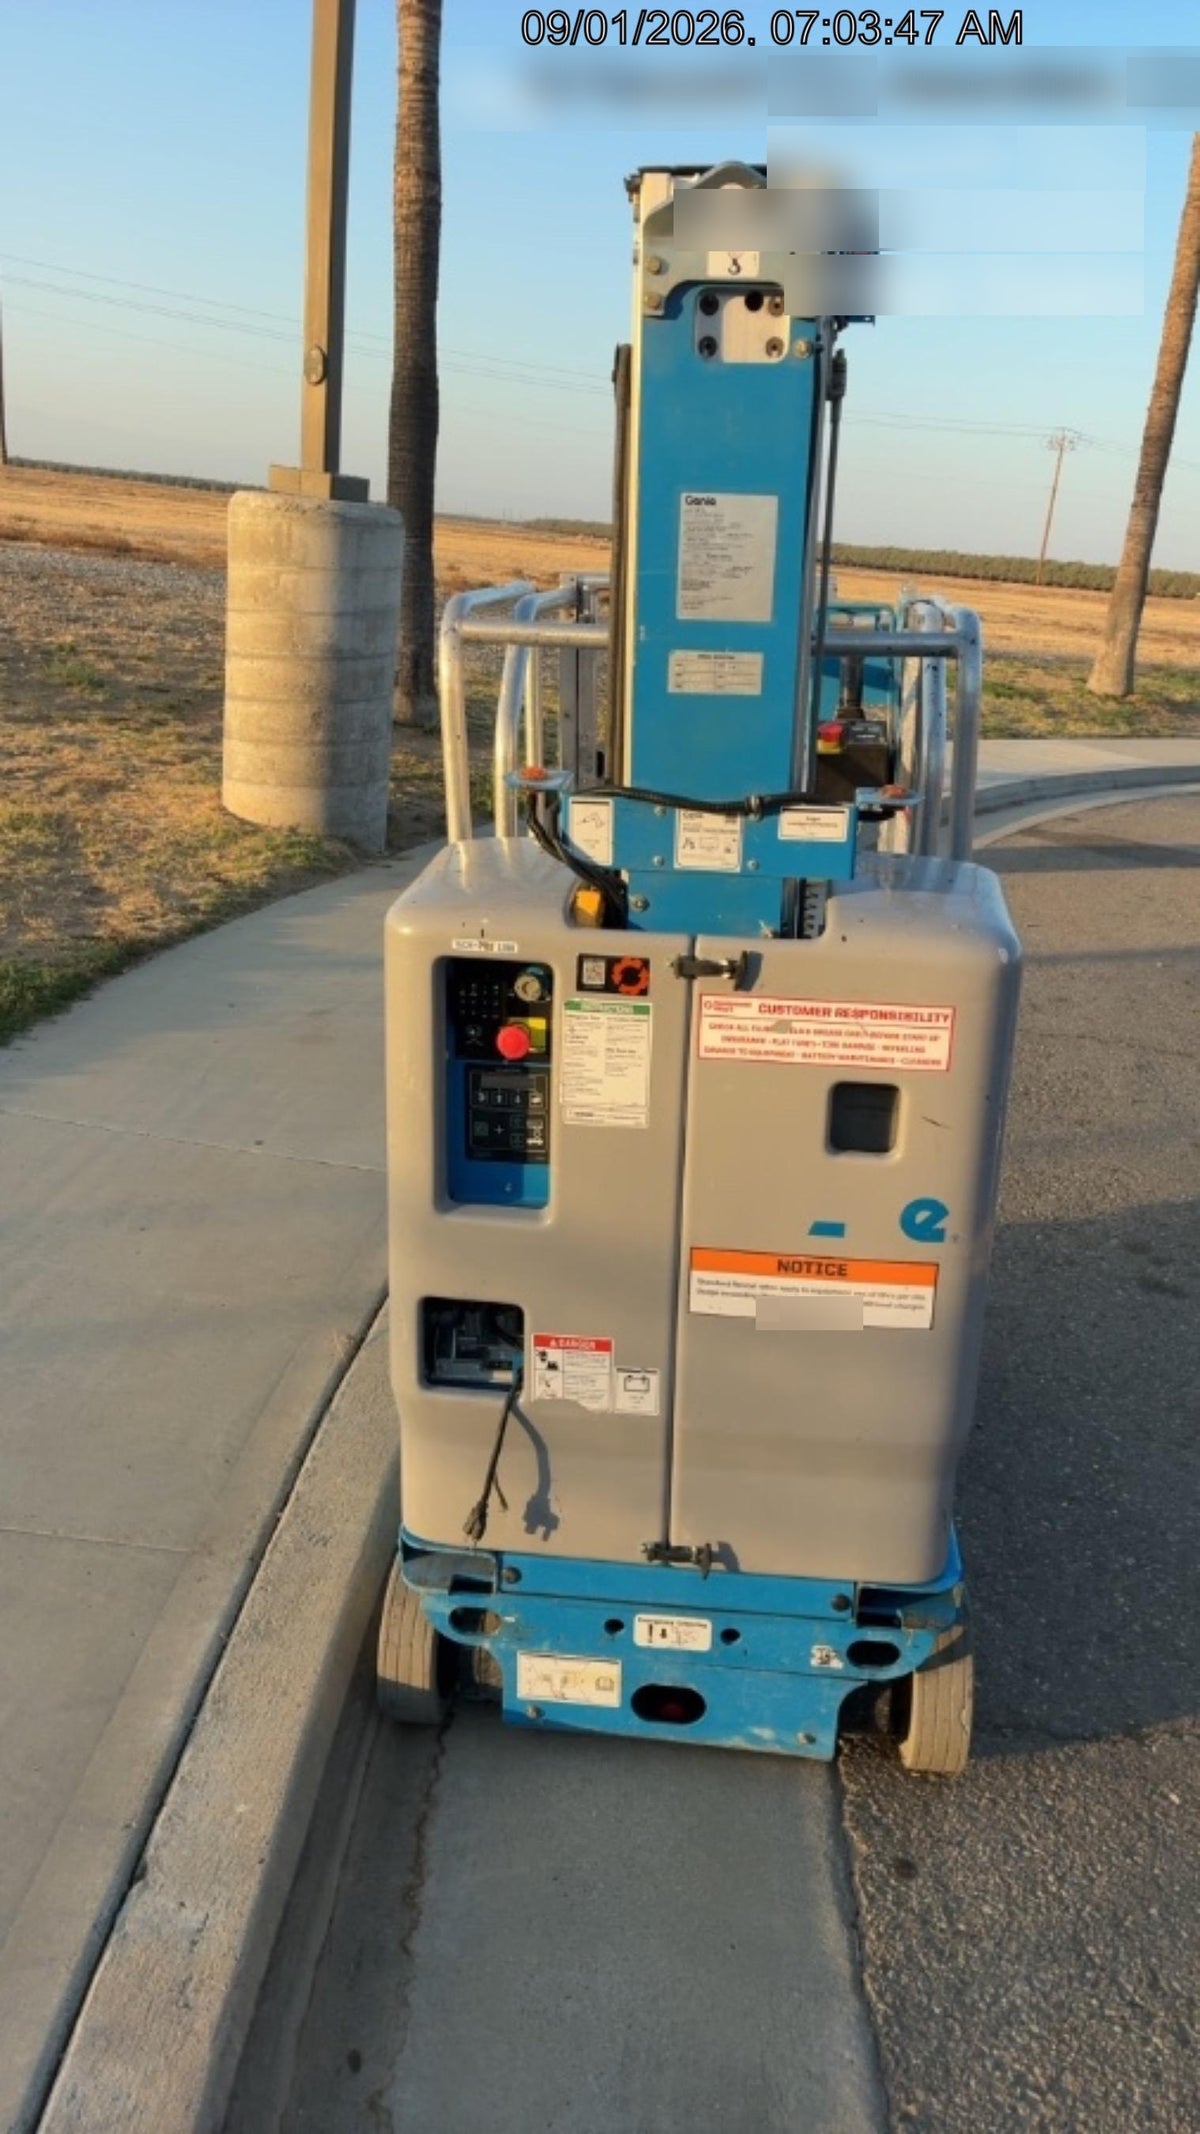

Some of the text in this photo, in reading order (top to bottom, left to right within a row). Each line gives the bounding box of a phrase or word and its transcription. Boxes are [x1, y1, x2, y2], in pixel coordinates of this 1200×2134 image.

[685, 495, 717, 506] Genie
[758, 1003, 832, 1018] CUSTOMER
[834, 1008, 950, 1024] RESPONSIBILITY
[777, 1260, 847, 1276] NOTICE
